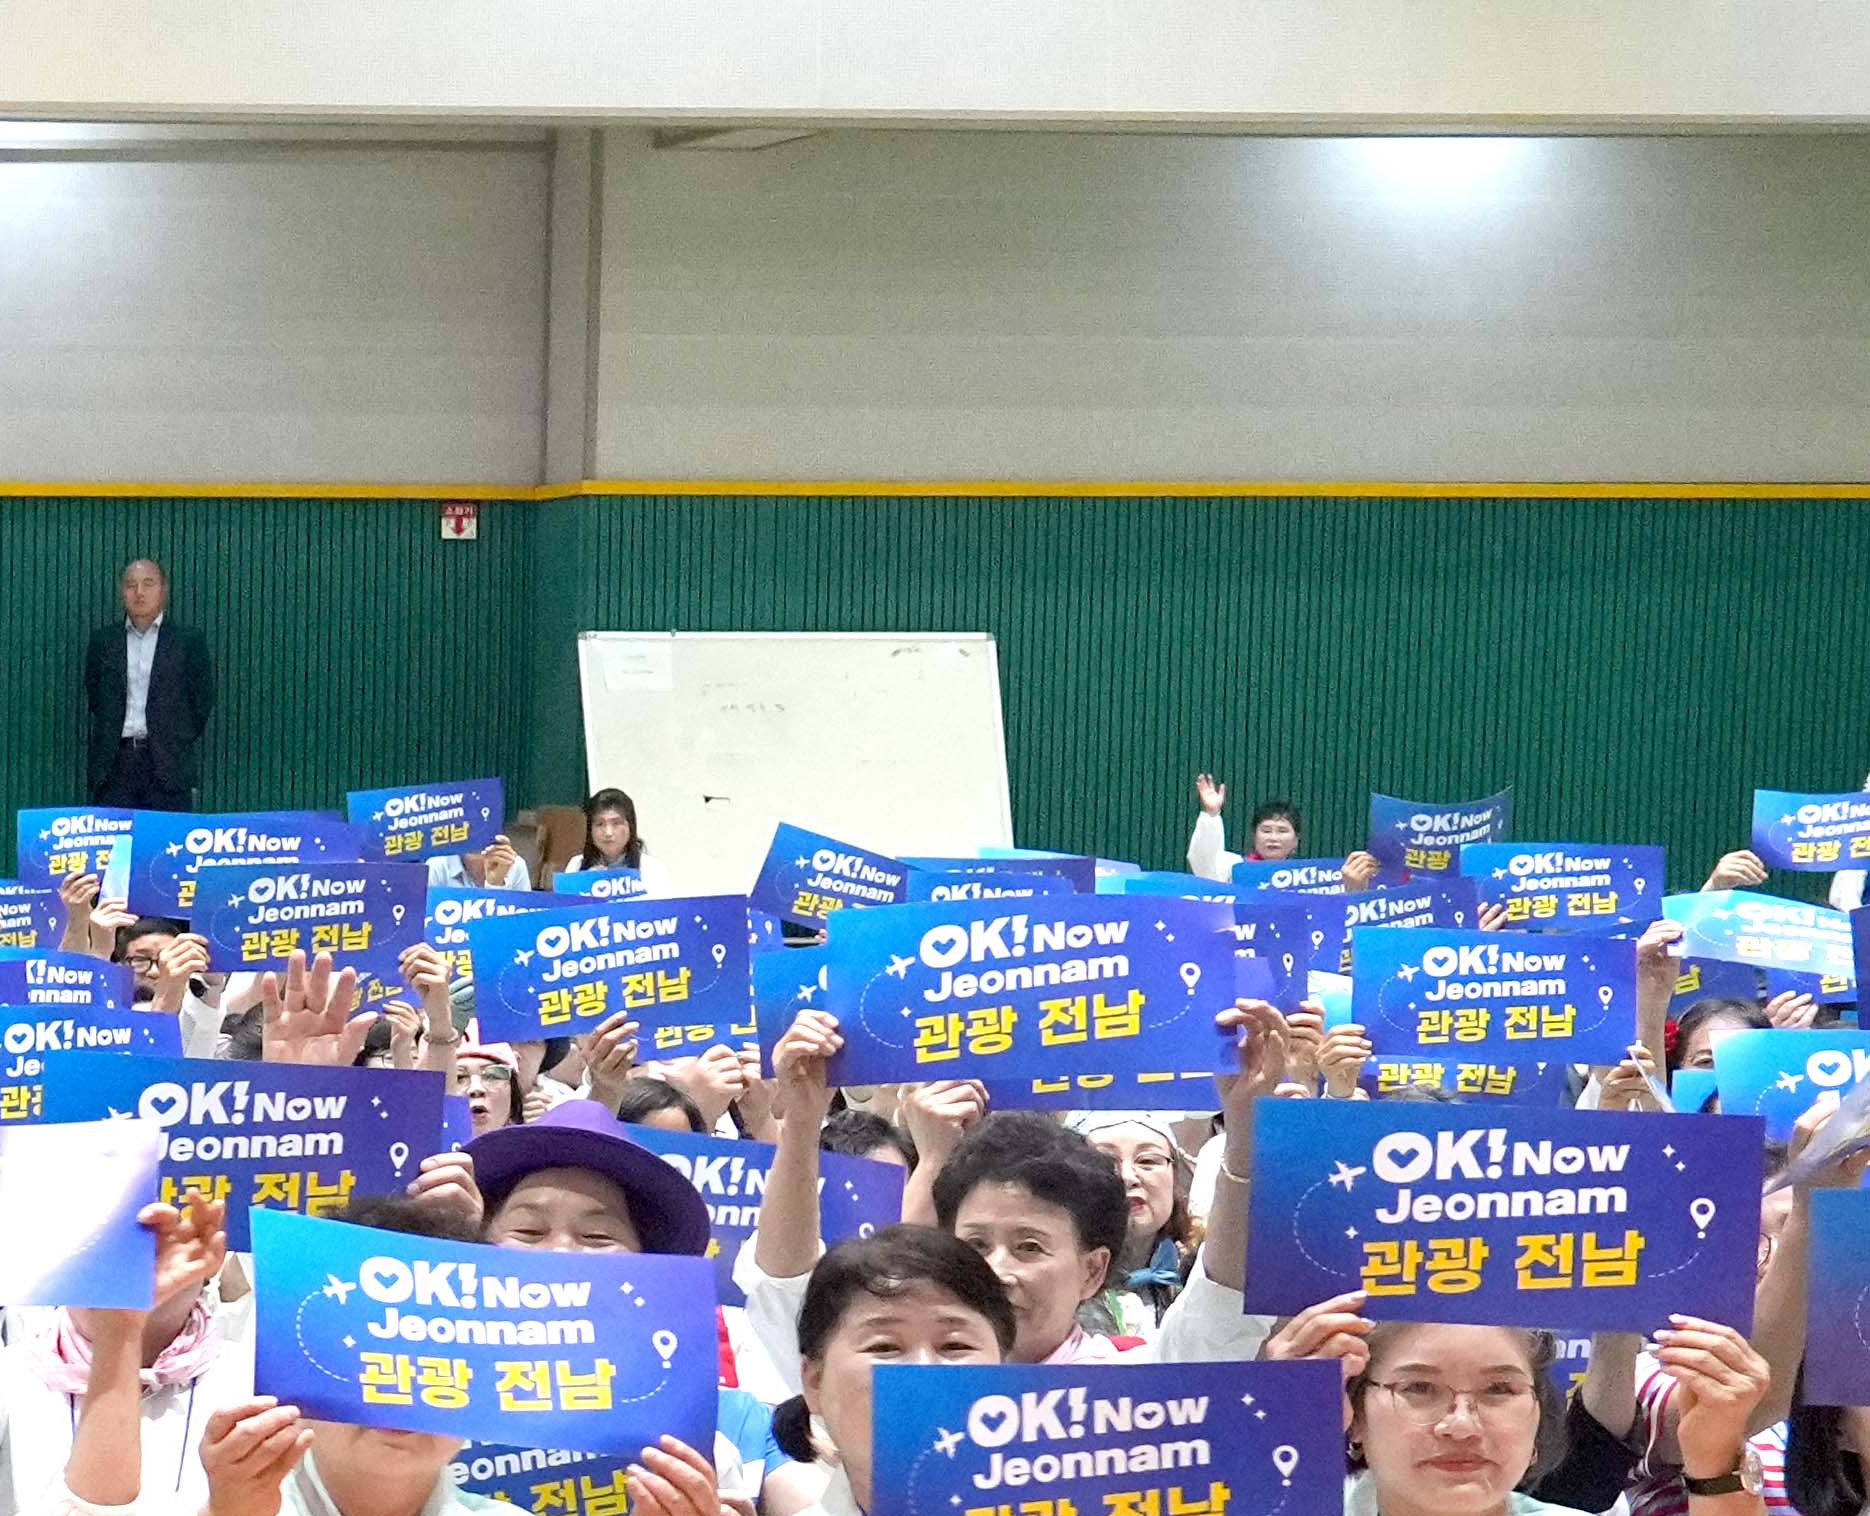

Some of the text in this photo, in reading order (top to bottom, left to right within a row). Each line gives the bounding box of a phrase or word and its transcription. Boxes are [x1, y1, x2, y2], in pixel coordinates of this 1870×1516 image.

[385, 793, 463, 816] OK! Now
[388, 807, 464, 830] Jeonnam
[385, 822, 469, 855] 관광 전남
[1509, 852, 1611, 876] OK! Now
[1511, 875, 1611, 892] Jeonnam
[249, 874, 366, 903] OK! Now
[1507, 892, 1618, 922] 관광 전남
[248, 900, 364, 923] Jeonnam
[242, 922, 373, 961] 관광 전남
[537, 916, 677, 957] OK! Now
[920, 915, 1129, 968] OK! Now
[542, 943, 679, 981] Jeonnam
[924, 955, 1128, 1001] Jeonnam
[539, 967, 691, 1025] 관광 전남
[915, 989, 1145, 1063] 관광 전남
[1373, 1129, 1630, 1183] OK! Now
[1376, 1187, 1627, 1223] Jeonnam
[1360, 1230, 1645, 1293] 관광 전남
[360, 1257, 591, 1309] OK! Now
[368, 1308, 595, 1345] Jeonnam
[360, 1353, 616, 1411] 관광 전남
[968, 1387, 1208, 1447] OK! Now
[973, 1440, 1209, 1489] Jeonnam
